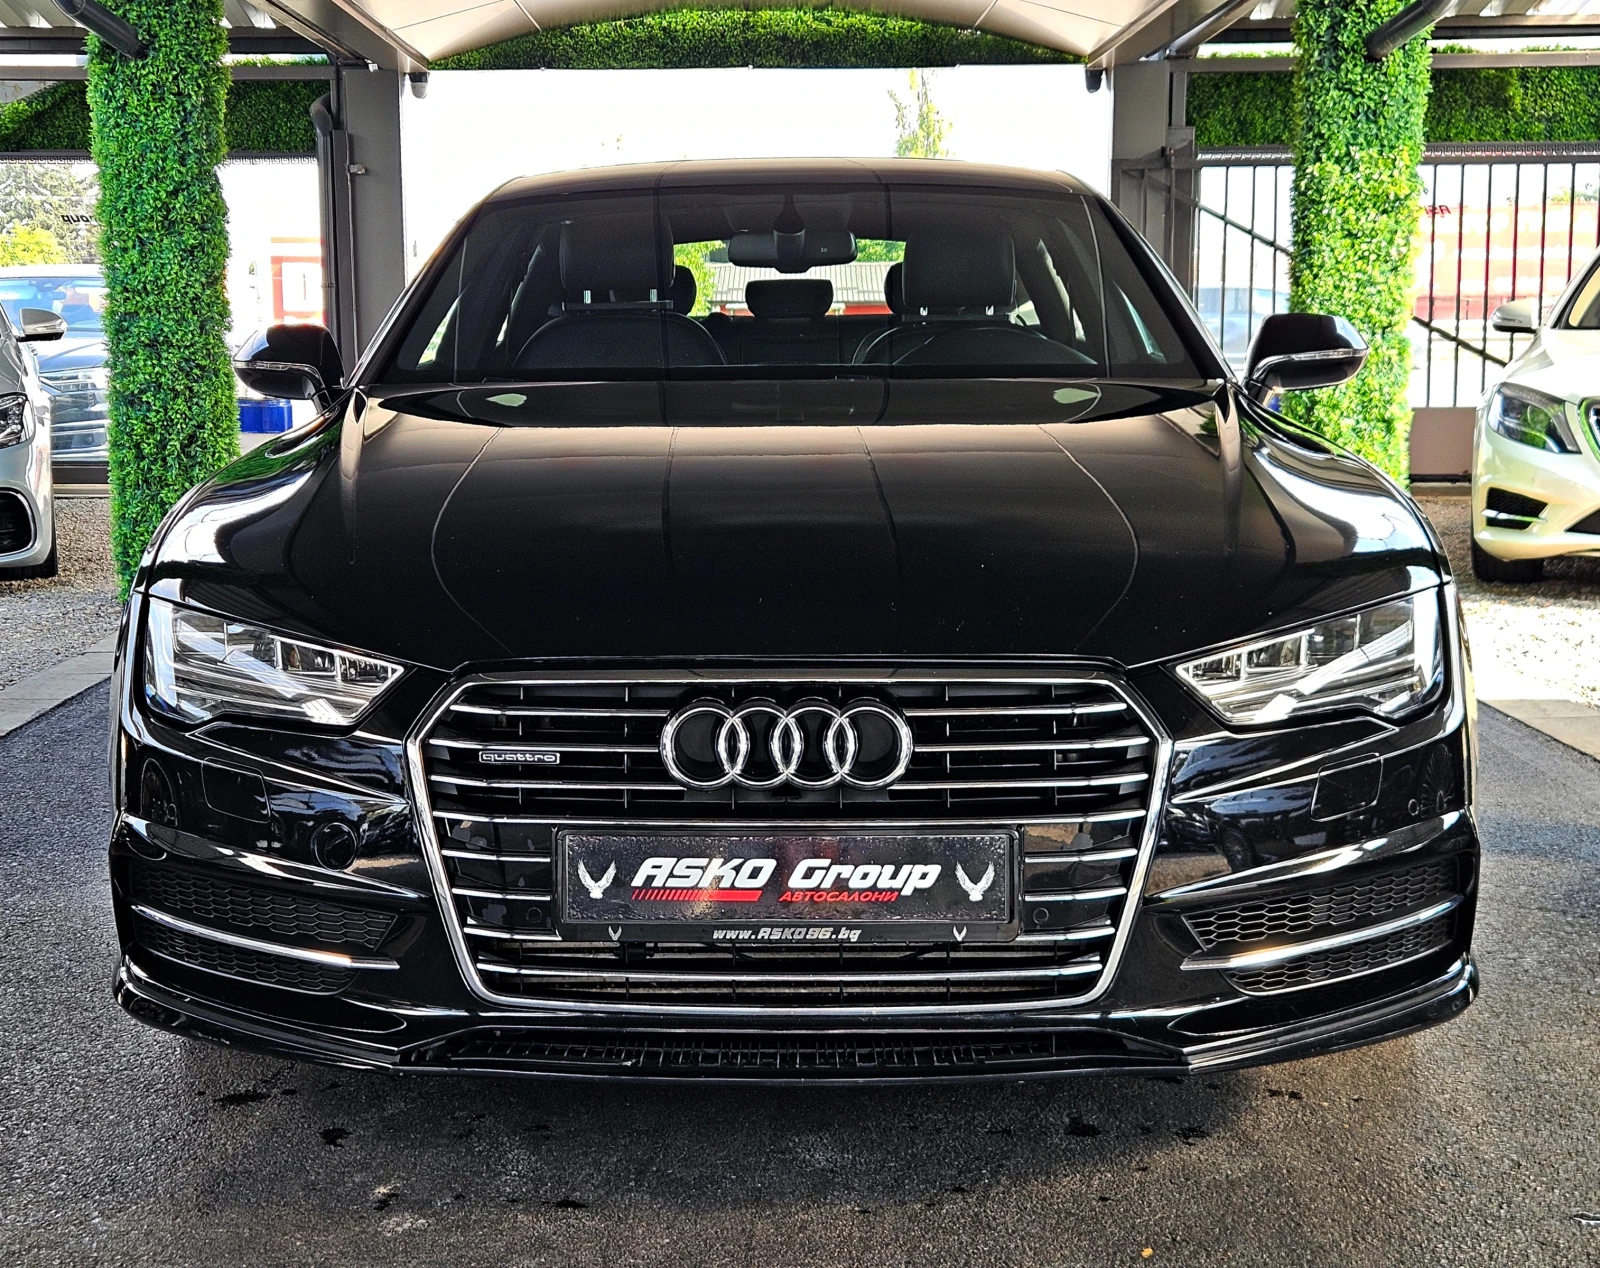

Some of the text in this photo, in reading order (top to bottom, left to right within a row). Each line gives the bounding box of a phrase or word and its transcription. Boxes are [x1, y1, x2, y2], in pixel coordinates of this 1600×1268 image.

[482, 753, 556, 762] quattro
[630, 857, 942, 896] ASKO Group
[779, 890, 899, 902] АВТОСАЛОНИ
[712, 927, 862, 942] www.ASKO96.bg
